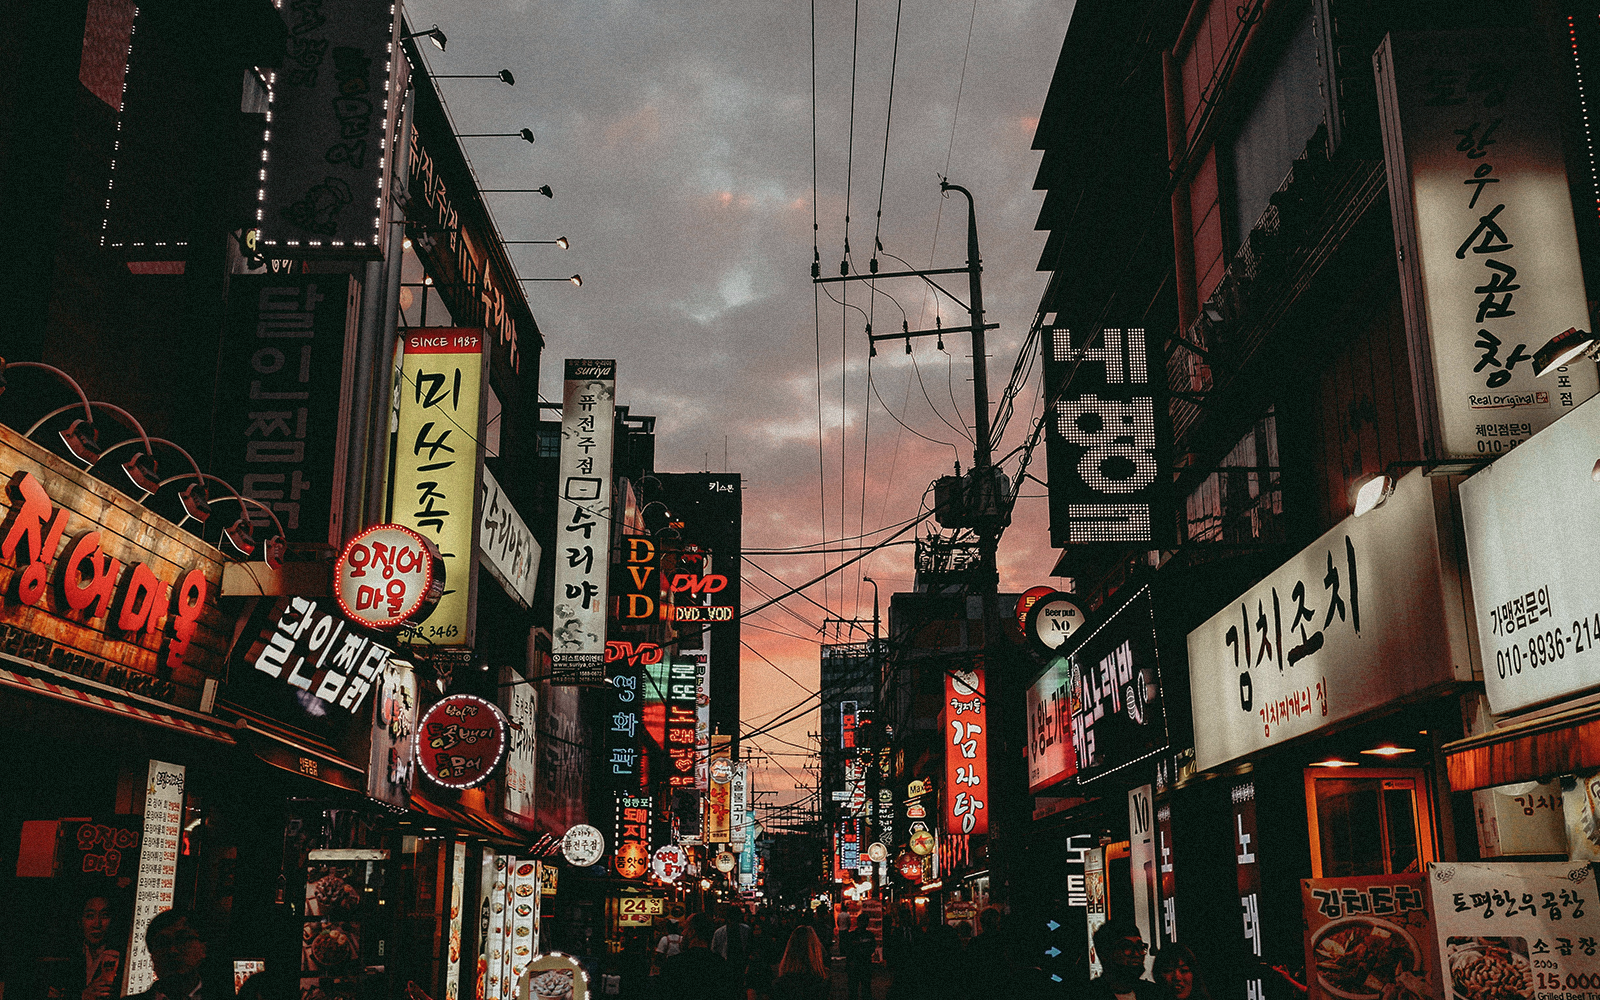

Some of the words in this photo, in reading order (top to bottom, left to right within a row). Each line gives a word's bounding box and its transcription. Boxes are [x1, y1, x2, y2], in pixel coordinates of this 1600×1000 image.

[410, 337, 449, 348] SINCE
[453, 336, 479, 348] 1987
[574, 365, 611, 378] suriya
[1468, 395, 1493, 406] Real
[576, 394, 598, 474] 퓨전주점
[1475, 423, 1532, 437] 체인점문의
[707, 481, 735, 493] 키스톤
[347, 541, 424, 580] 오징어
[565, 506, 599, 610] 수리야
[626, 538, 655, 619] DVD
[670, 573, 728, 593] DVD
[356, 578, 406, 618] 마을
[1045, 608, 1060, 620] Beer
[1062, 609, 1076, 622] pub
[1490, 585, 1552, 637] 가맹점문의
[429, 624, 459, 638] 3463
[1051, 619, 1070, 632] No
[1225, 535, 1361, 712] 김치조치
[253, 596, 391, 715] 달인찜닭
[604, 640, 664, 667] DVD
[950, 698, 981, 715] 형제들
[1259, 686, 1312, 738] 김치찌개의
[1316, 676, 1328, 717] 집
[435, 752, 483, 779] 통문어
[950, 720, 984, 834] 감자탕
[733, 770, 745, 824] 서울불고기
[909, 785, 926, 795] Max
[622, 797, 649, 808] 영등포
[77, 823, 140, 850] 오징어
[565, 839, 597, 852] 퓨전주점
[82, 849, 122, 877] 마을
[616, 855, 647, 869] 품앗이
[624, 899, 648, 914] 24
[1452, 889, 1537, 919] 토평한우
[1541, 889, 1585, 921] 곱창
[1533, 959, 1559, 970] 200g
[1537, 992, 1564, 1000] Grilled
[1566, 992, 1585, 1000] Beef
